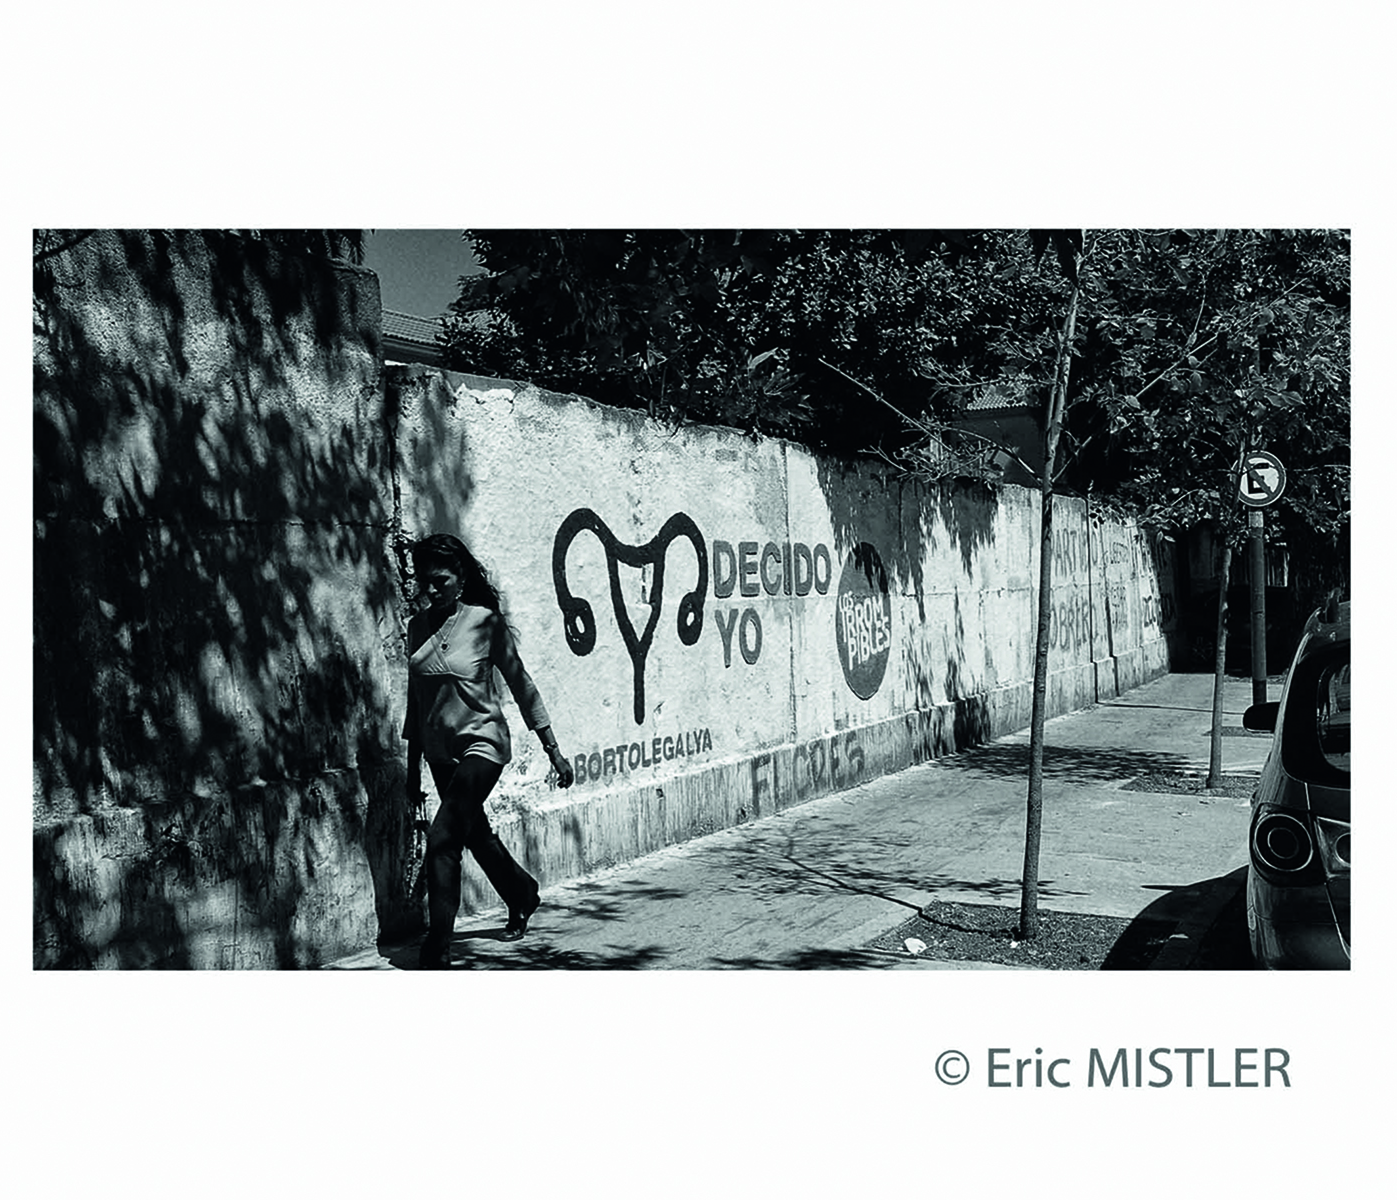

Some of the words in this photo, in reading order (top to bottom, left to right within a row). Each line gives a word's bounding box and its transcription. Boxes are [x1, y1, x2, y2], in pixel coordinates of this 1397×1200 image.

[712, 540, 831, 598] DECIDO
[714, 607, 762, 668] YO
[545, 727, 713, 792] #BORTOLEGALYA
